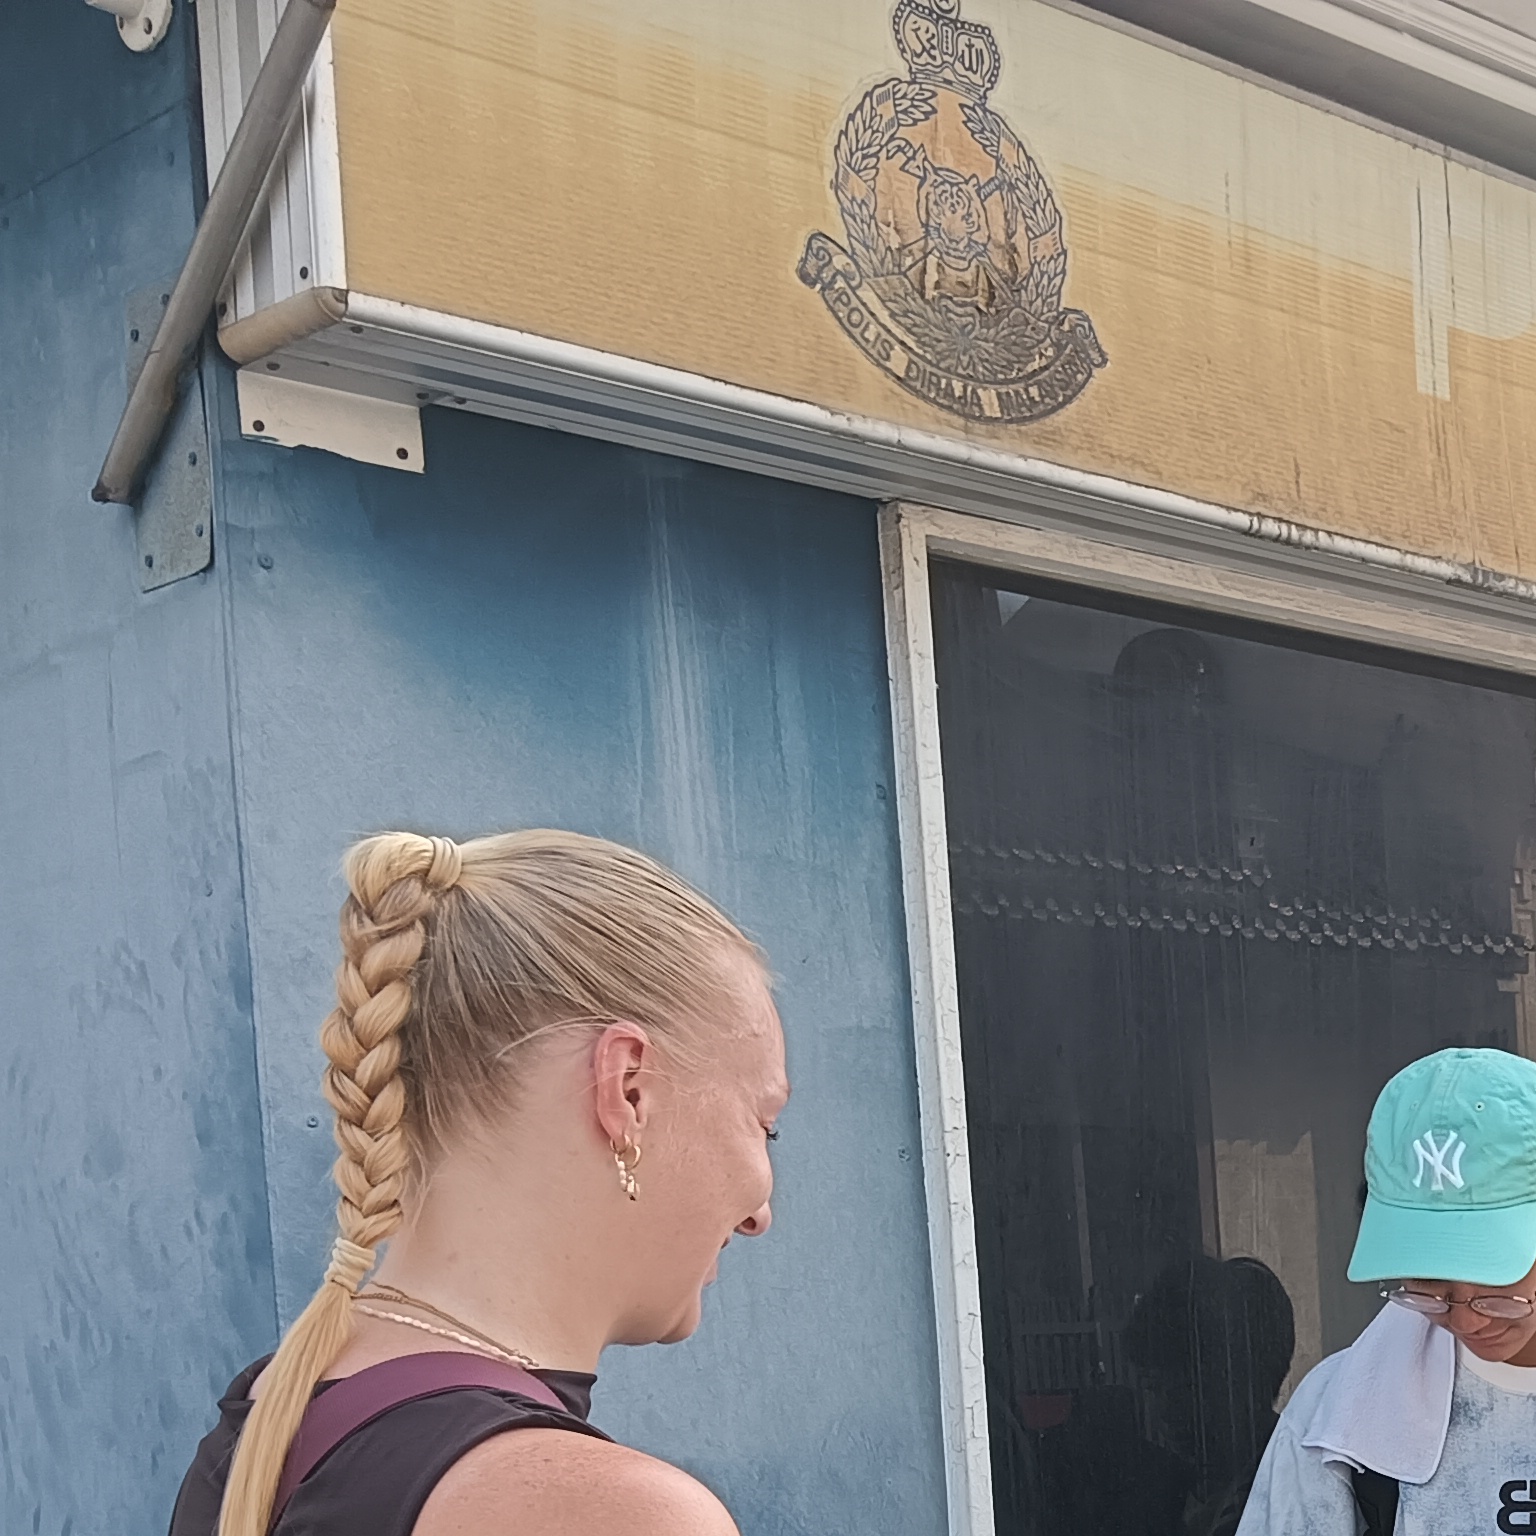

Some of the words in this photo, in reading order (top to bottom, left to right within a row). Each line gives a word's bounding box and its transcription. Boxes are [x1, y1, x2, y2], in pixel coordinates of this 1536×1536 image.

[832, 288, 894, 362] POLIS
[904, 360, 983, 415] DIRAJA
[1412, 1129, 1467, 1191] NY
